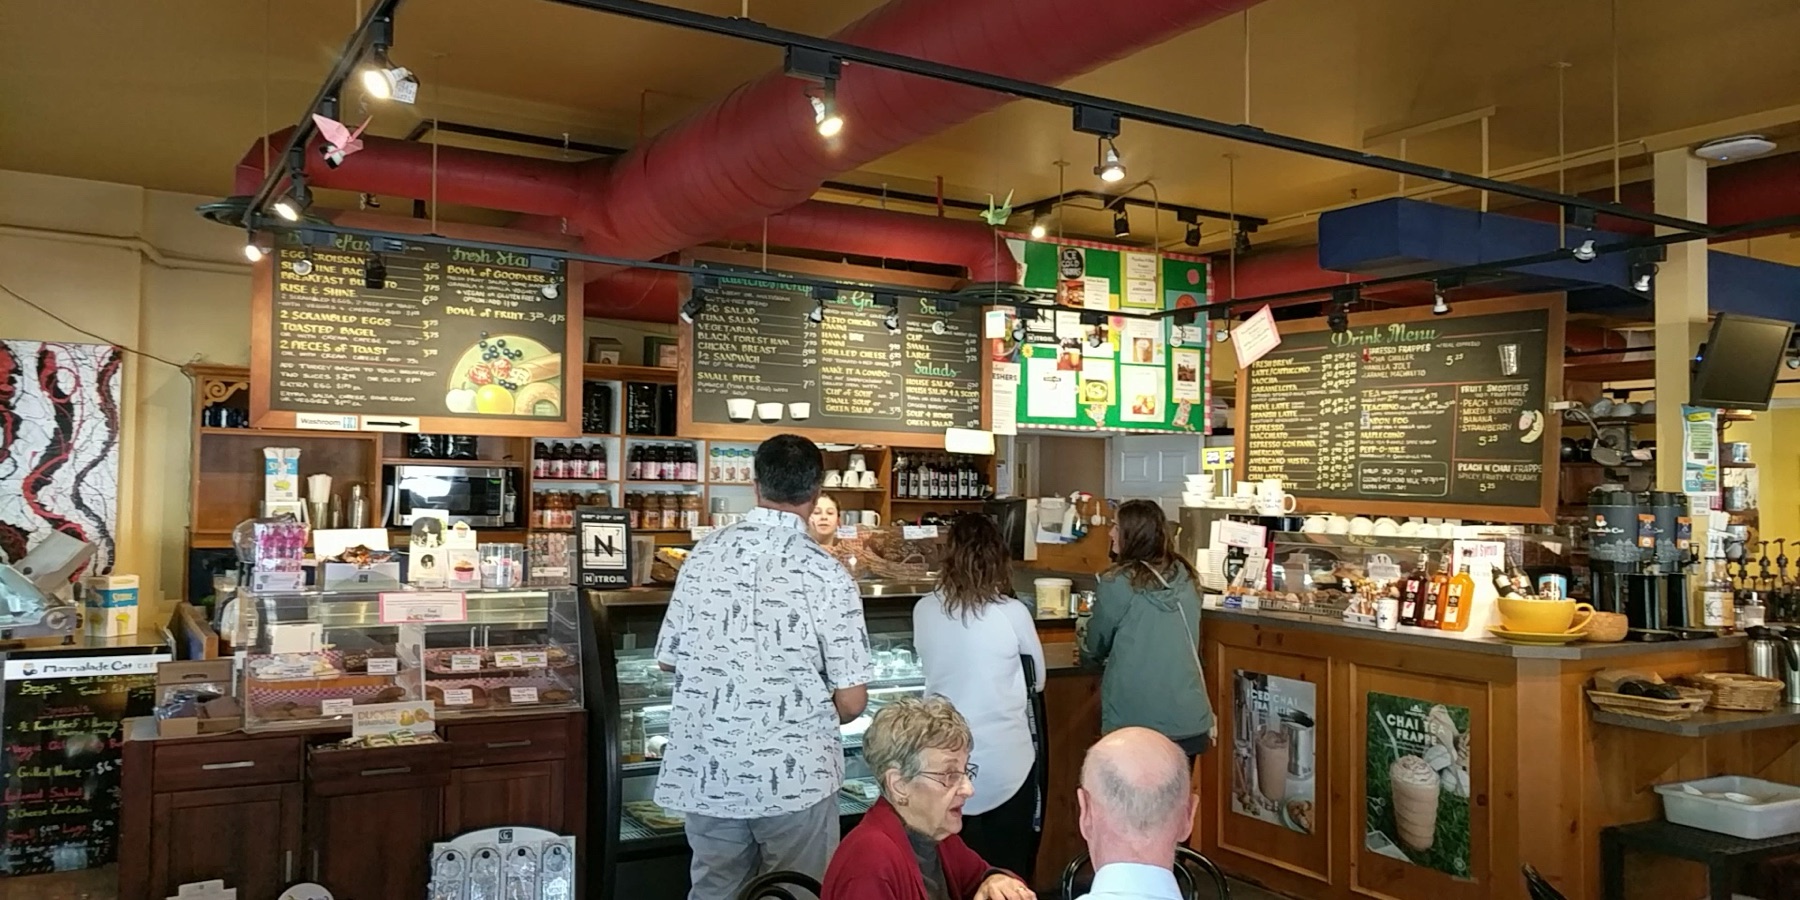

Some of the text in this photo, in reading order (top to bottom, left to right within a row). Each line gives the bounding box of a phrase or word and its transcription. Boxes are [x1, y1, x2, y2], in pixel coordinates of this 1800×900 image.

[1063, 251, 1077, 260] ICE
[281, 272, 345, 285] BREAKFAST
[447, 265, 477, 276] BOWL
[493, 270, 546, 283] GOODNESS
[280, 283, 308, 294] RISE
[323, 286, 357, 298] SHINE
[446, 306, 477, 317] BOWL
[724, 306, 756, 314] SALAD
[280, 310, 392, 326] 2 SCRAMBLED EGGS
[728, 316, 760, 324] SALAD
[847, 318, 878, 327] CHICKEN
[280, 323, 377, 337] TOASTED BAGEL
[698, 323, 758, 334] VEGETARIAN
[698, 332, 731, 341] BLACK
[1331, 323, 1440, 347] Drink Menu
[280, 341, 289, 349] 2
[291, 341, 331, 352] PIECES
[350, 345, 389, 355] TOAST
[698, 342, 777, 354] CHICKEN BREAST
[1398, 344, 1431, 353] FRAPPES
[714, 353, 760, 363] SANDWICH
[822, 349, 887, 359] GRILLED CHEESE
[914, 360, 961, 377] Salads
[698, 372, 761, 382] SMALL BITES
[1252, 377, 1278, 385] MOCHA
[854, 389, 873, 397] SOUP
[1460, 384, 1529, 393] FRUIT SMOOTHIES
[825, 397, 850, 405] SMALL
[851, 406, 874, 414] SALAD
[1278, 410, 1298, 418] LATTE
[301, 418, 341, 426] Washroom
[906, 419, 930, 427] GREEN
[1457, 463, 1482, 472] PEACH
[1492, 464, 1511, 472] CHAI
[594, 535, 613, 557] N
[585, 575, 616, 583] NITRO
[43, 661, 133, 674] Marmalade Cat
[1247, 689, 1299, 707] ICED CHAI
[1386, 713, 1447, 734] CHAI TEA
[1395, 729, 1438, 746] FRAPPE
